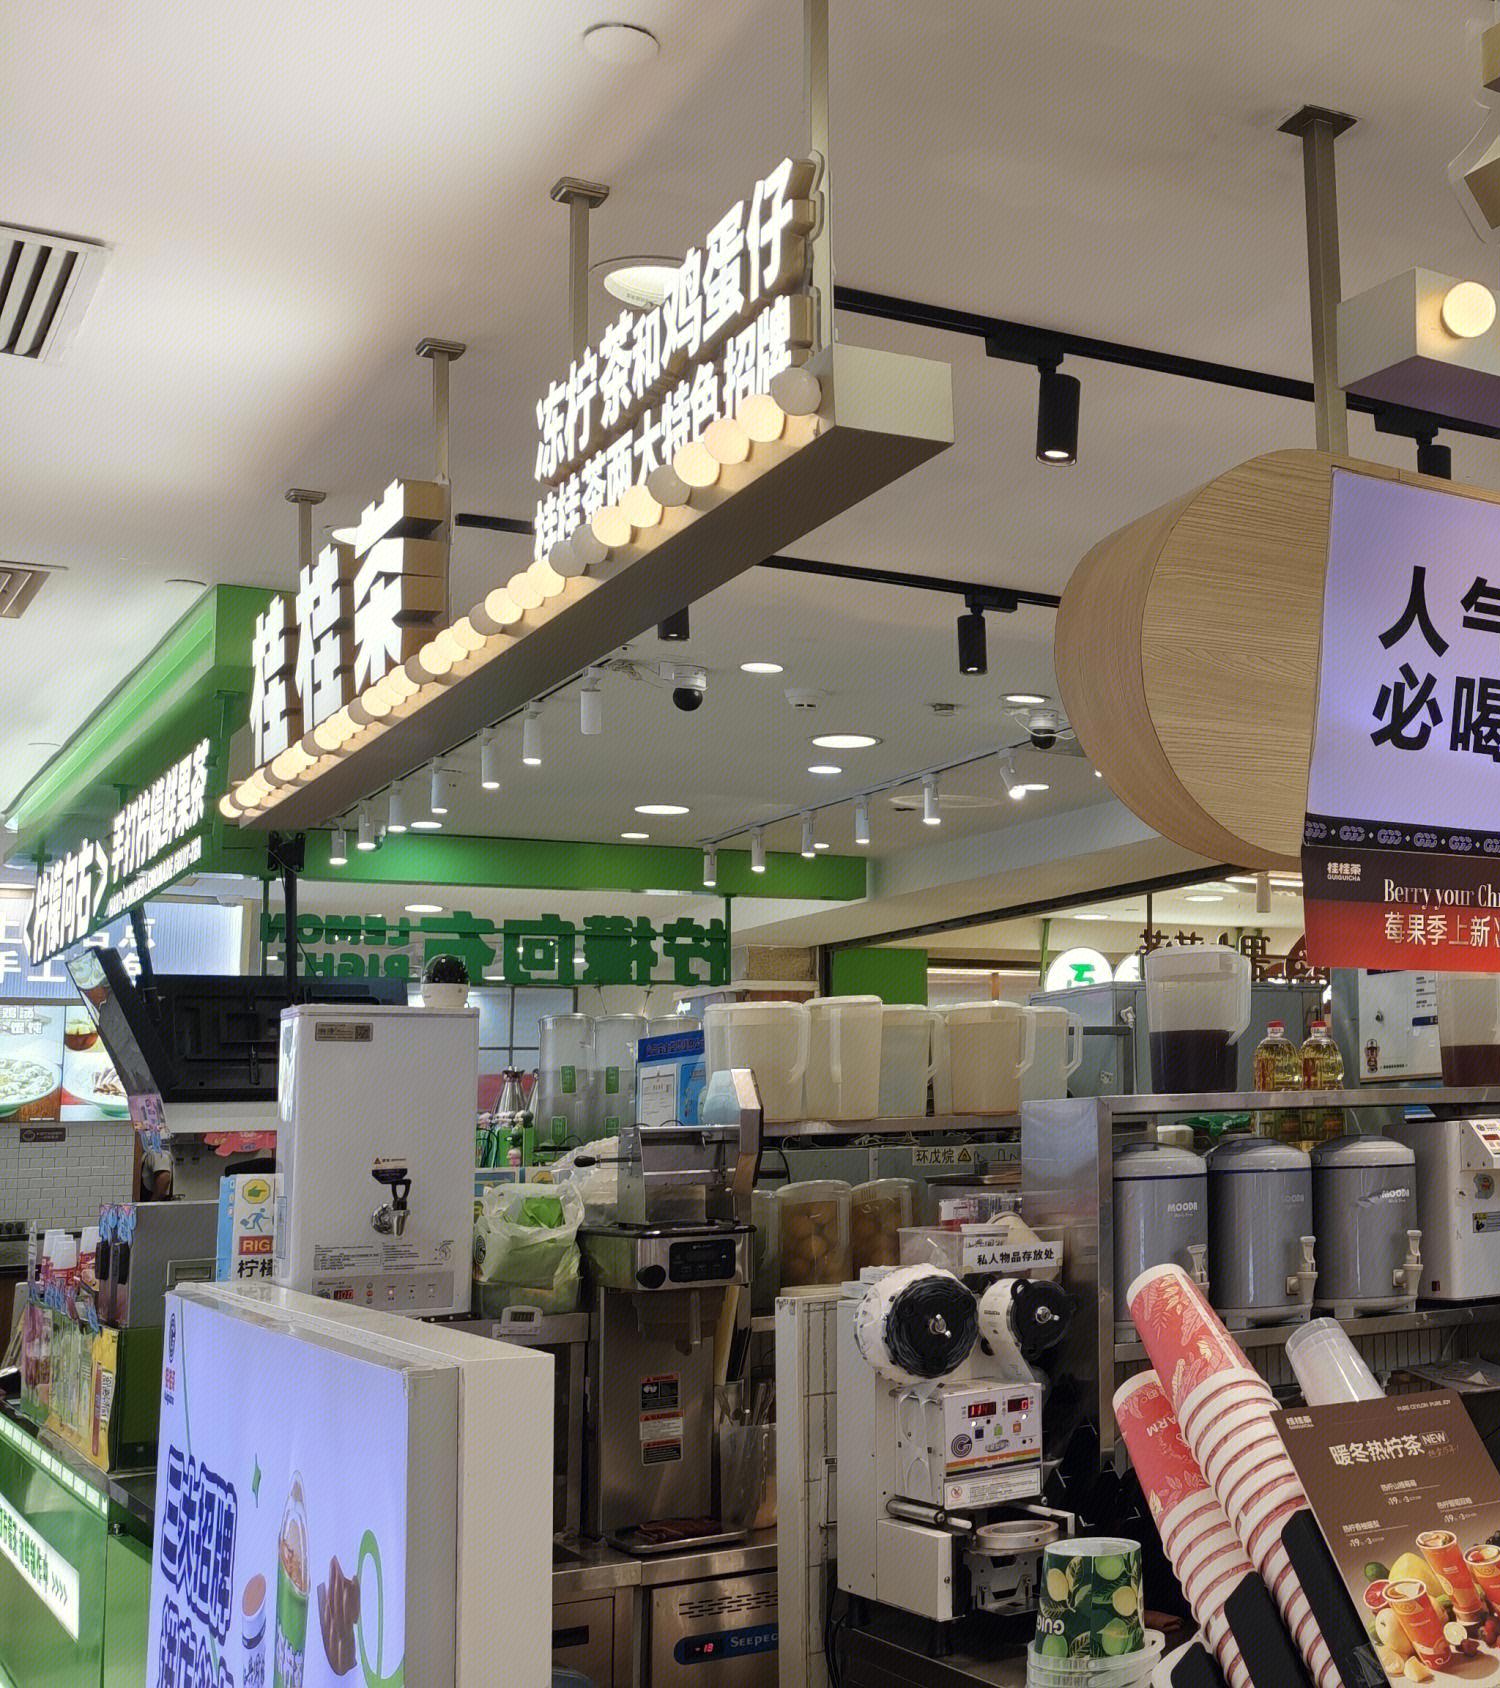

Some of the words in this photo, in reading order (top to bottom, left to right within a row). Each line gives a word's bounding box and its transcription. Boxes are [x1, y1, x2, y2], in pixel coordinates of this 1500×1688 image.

[535, 157, 792, 482] 冻柠茶和鸡蛋仔
[534, 295, 791, 561] 桂桂茶两大特色招牌
[250, 478, 404, 769] 桂桂茶
[1327, 862, 1361, 876] 桂桂茶
[1384, 878, 1430, 910] Berry
[1434, 886, 1474, 911] your
[1384, 911, 1490, 948] 莓果季上新
[916, 1149, 954, 1164] 环戊烷
[977, 1248, 1055, 1265] 私人物品存放处
[1329, 1434, 1425, 1466] 暖冬热柠茶
[1422, 1432, 1446, 1445] NEW
